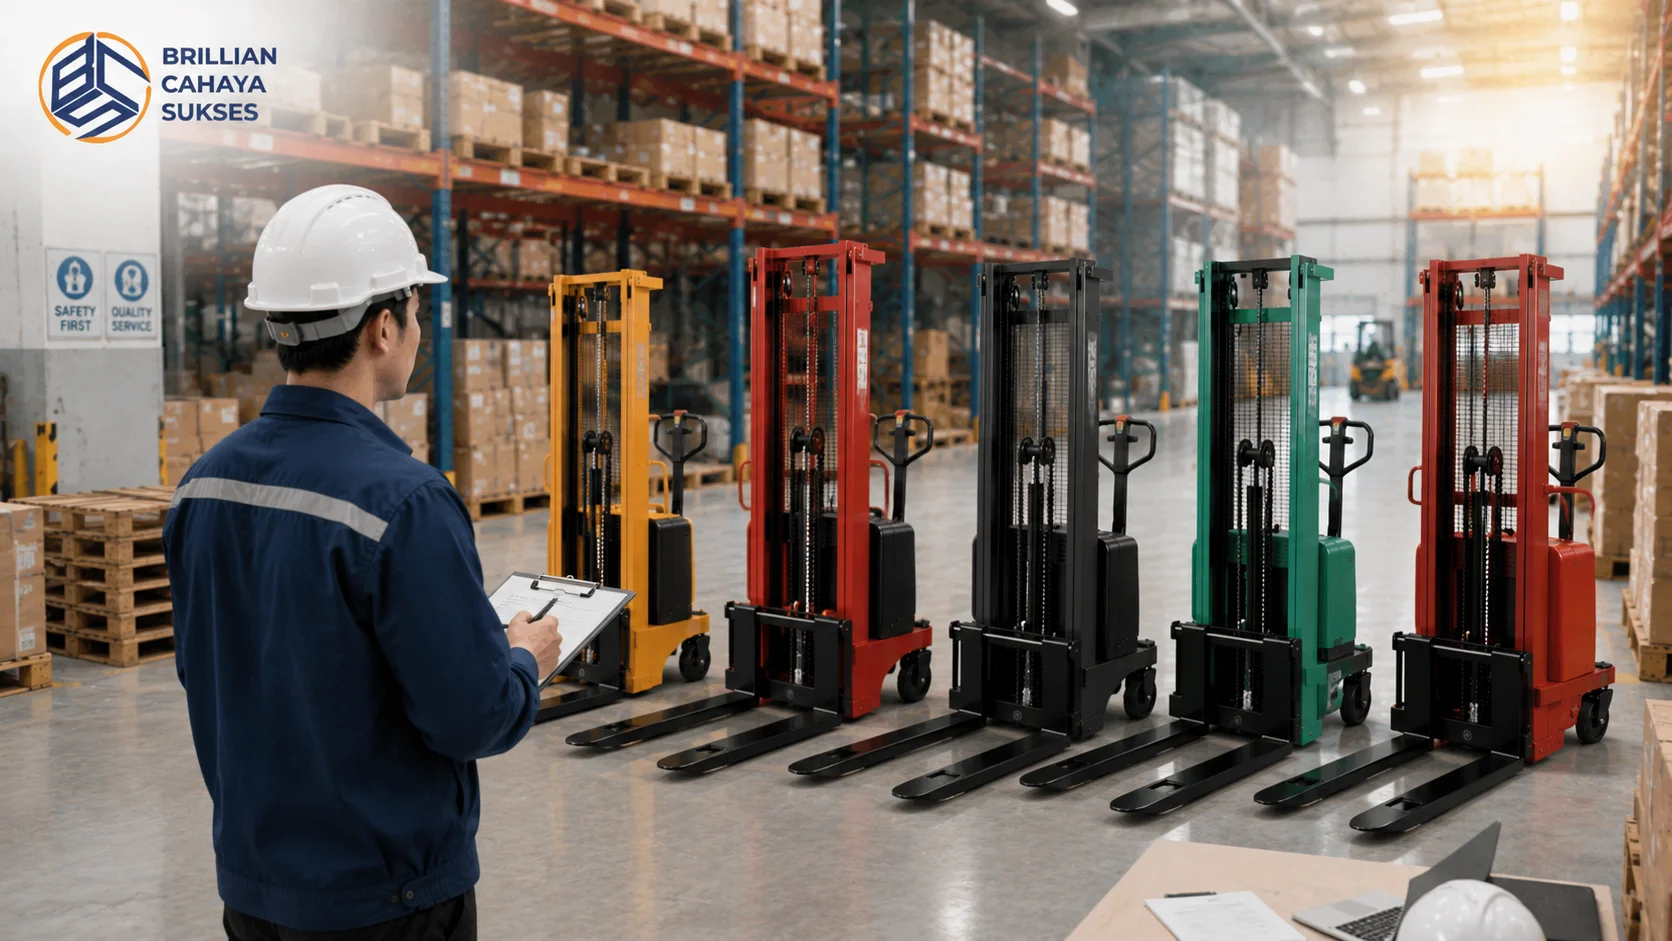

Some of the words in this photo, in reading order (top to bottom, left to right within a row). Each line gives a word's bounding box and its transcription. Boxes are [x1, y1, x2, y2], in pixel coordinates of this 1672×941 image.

[55, 305, 97, 317] SAFETY
[111, 306, 152, 317] QUALITY
[60, 319, 91, 331] FIRST
[112, 320, 152, 332] SERVICE
